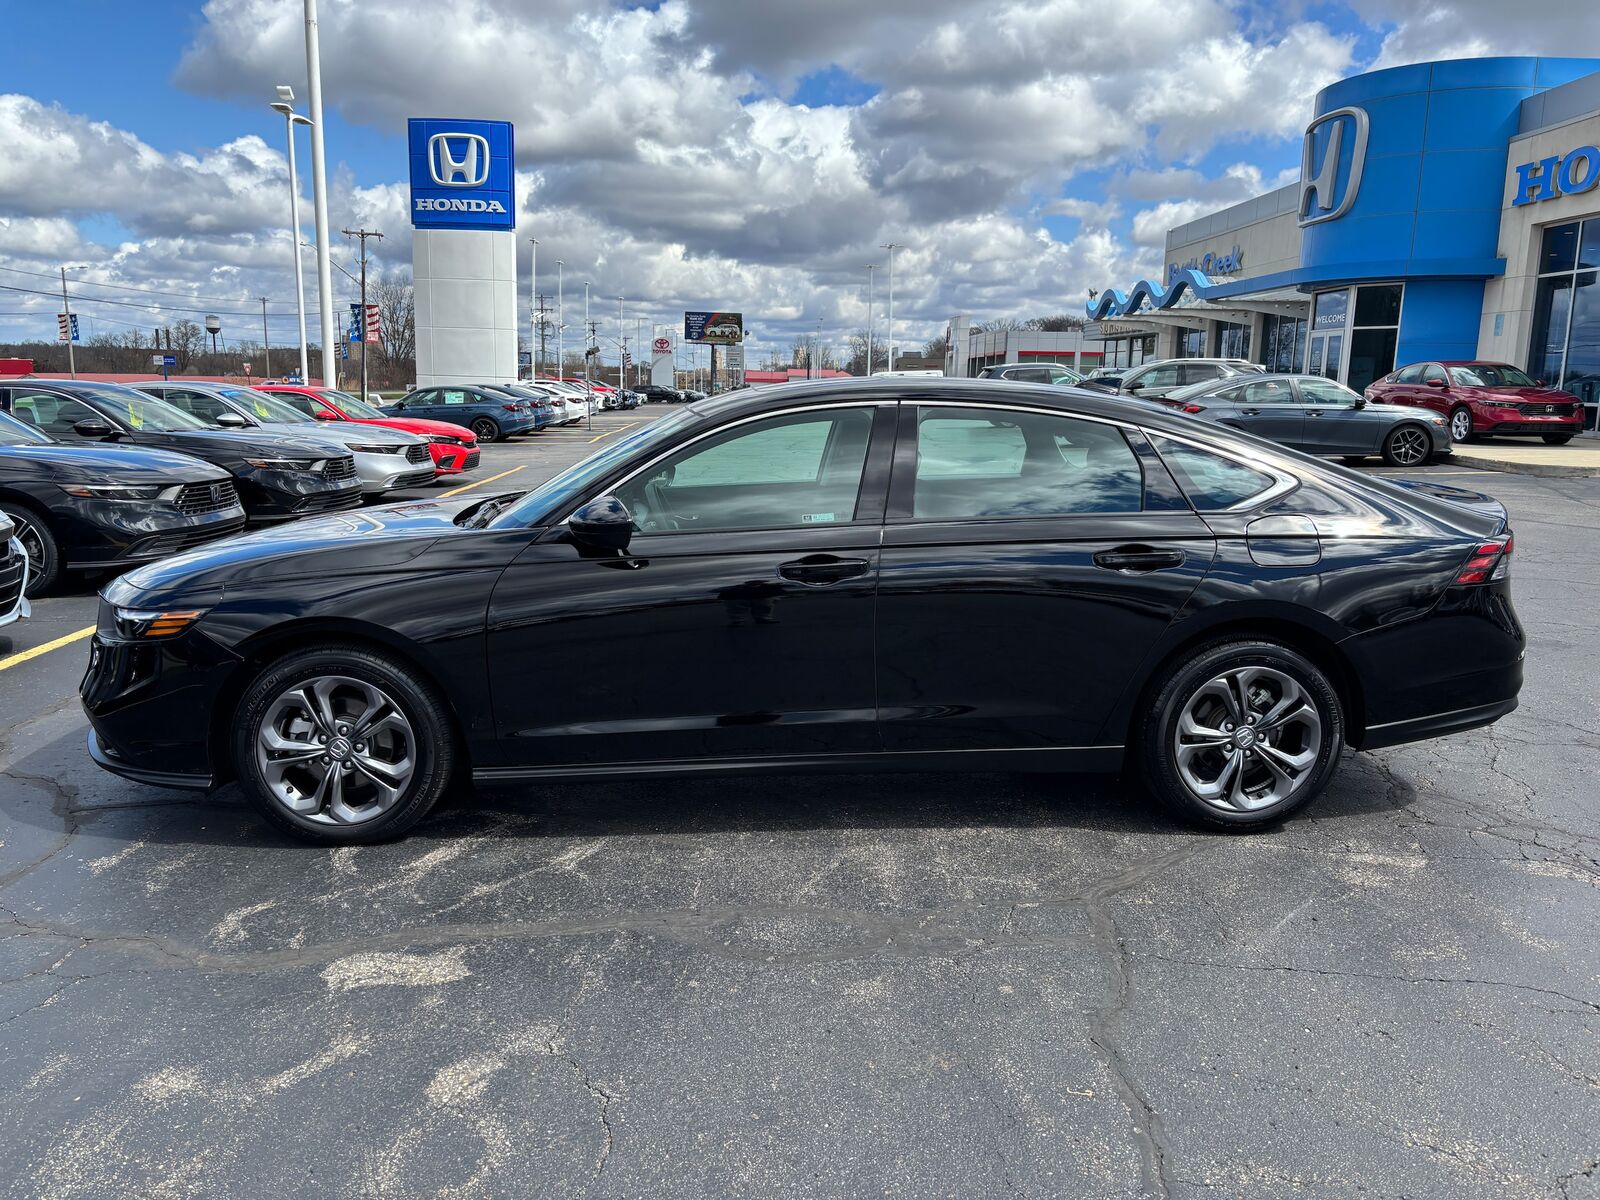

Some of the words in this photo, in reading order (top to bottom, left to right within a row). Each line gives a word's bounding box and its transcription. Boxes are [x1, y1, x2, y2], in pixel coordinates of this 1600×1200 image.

[415, 198, 507, 214] HONDA
[1202, 245, 1243, 275] Creek
[1316, 313, 1346, 324] WELCOME
